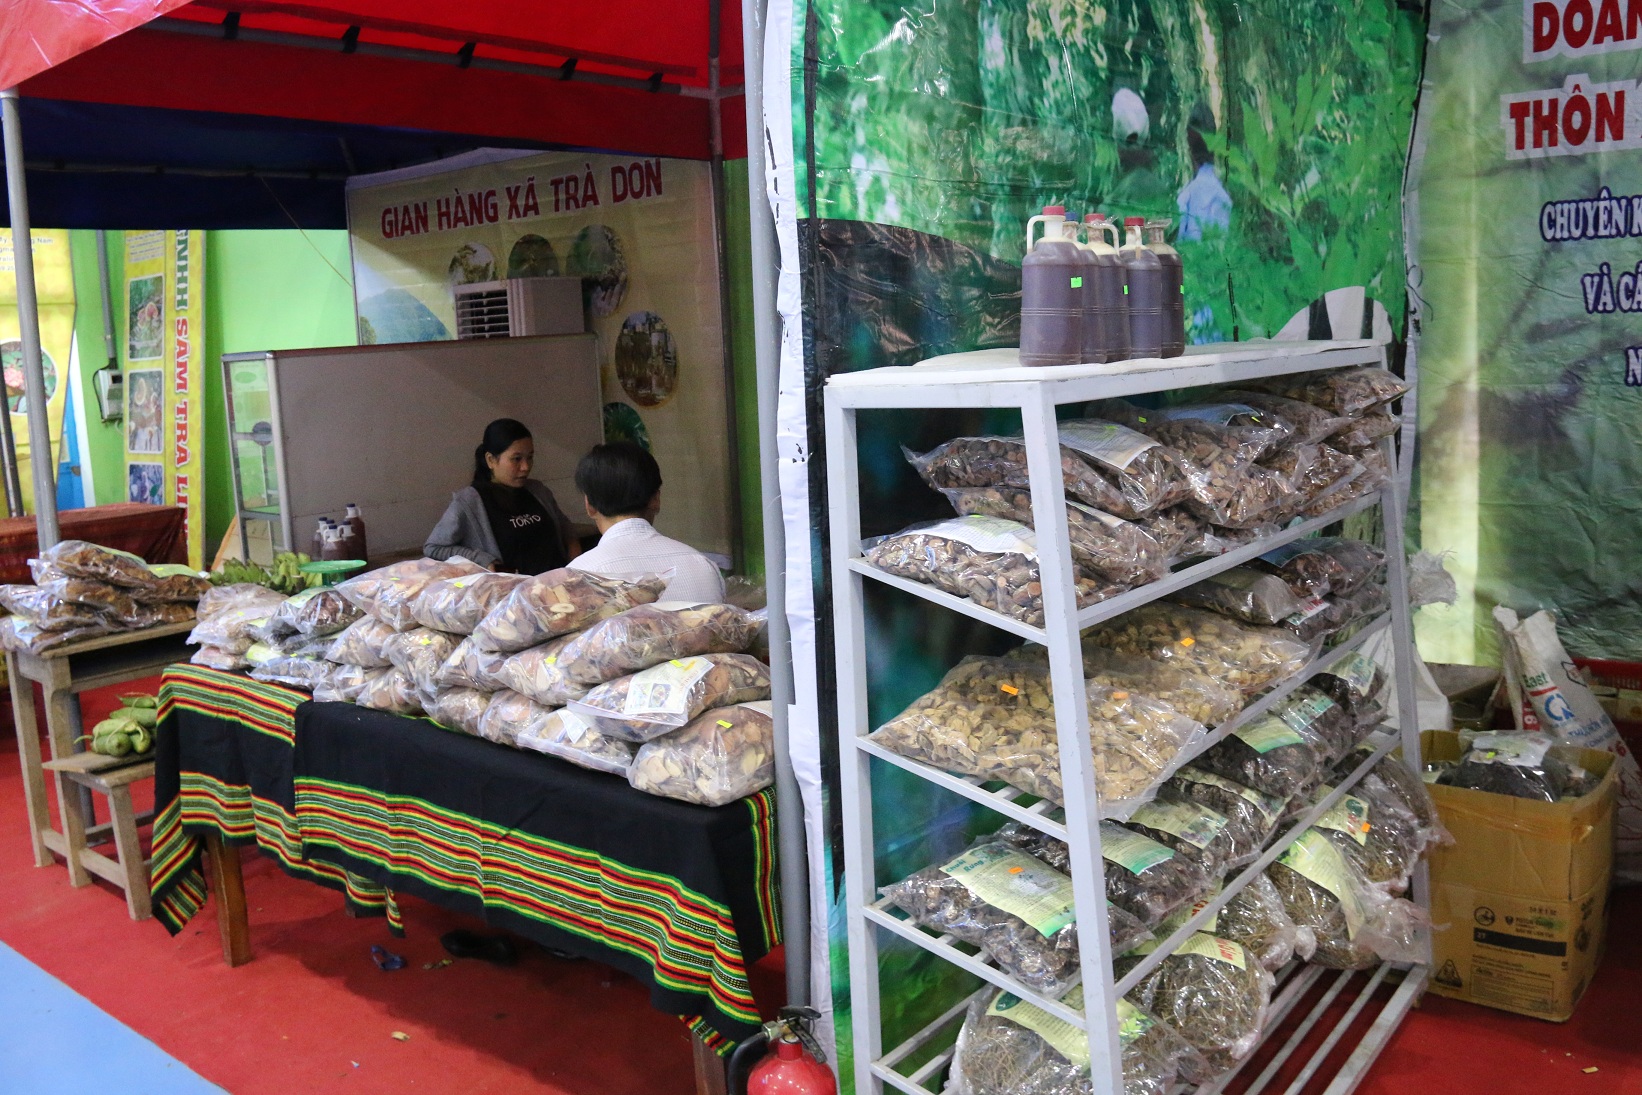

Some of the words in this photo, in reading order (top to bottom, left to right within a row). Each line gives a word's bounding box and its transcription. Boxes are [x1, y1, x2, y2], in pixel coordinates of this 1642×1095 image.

[1509, 83, 1626, 151] THÔN
[381, 201, 429, 239] GIAN
[436, 187, 499, 231] HÀNG
[505, 175, 540, 220] XÃ
[550, 162, 600, 212] TRÀ
[611, 157, 662, 203] DON
[1540, 187, 1627, 241] CHUYÊN
[1581, 262, 1616, 314] VÀ
